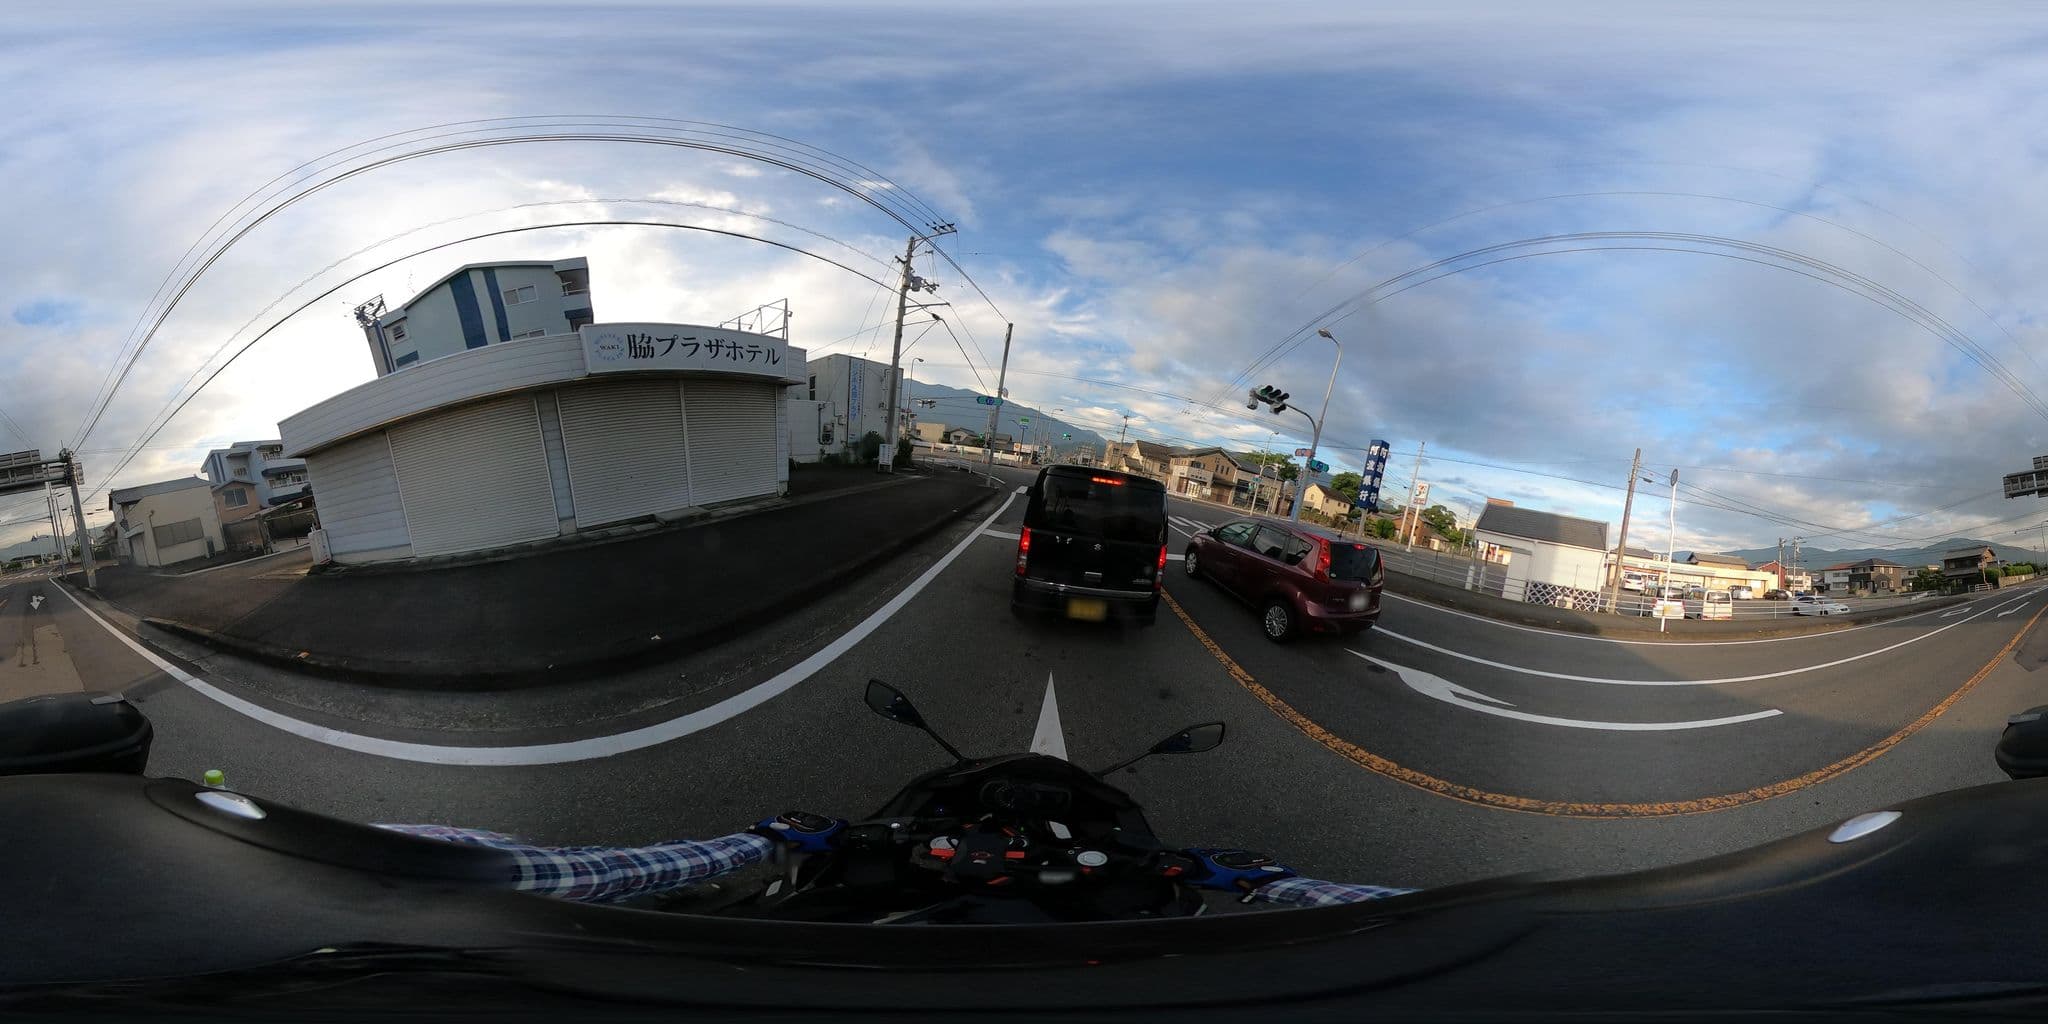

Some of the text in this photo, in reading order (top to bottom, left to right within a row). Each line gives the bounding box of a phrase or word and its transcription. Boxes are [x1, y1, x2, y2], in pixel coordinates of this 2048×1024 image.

[627, 333, 781, 366] 脇プラザホテル
